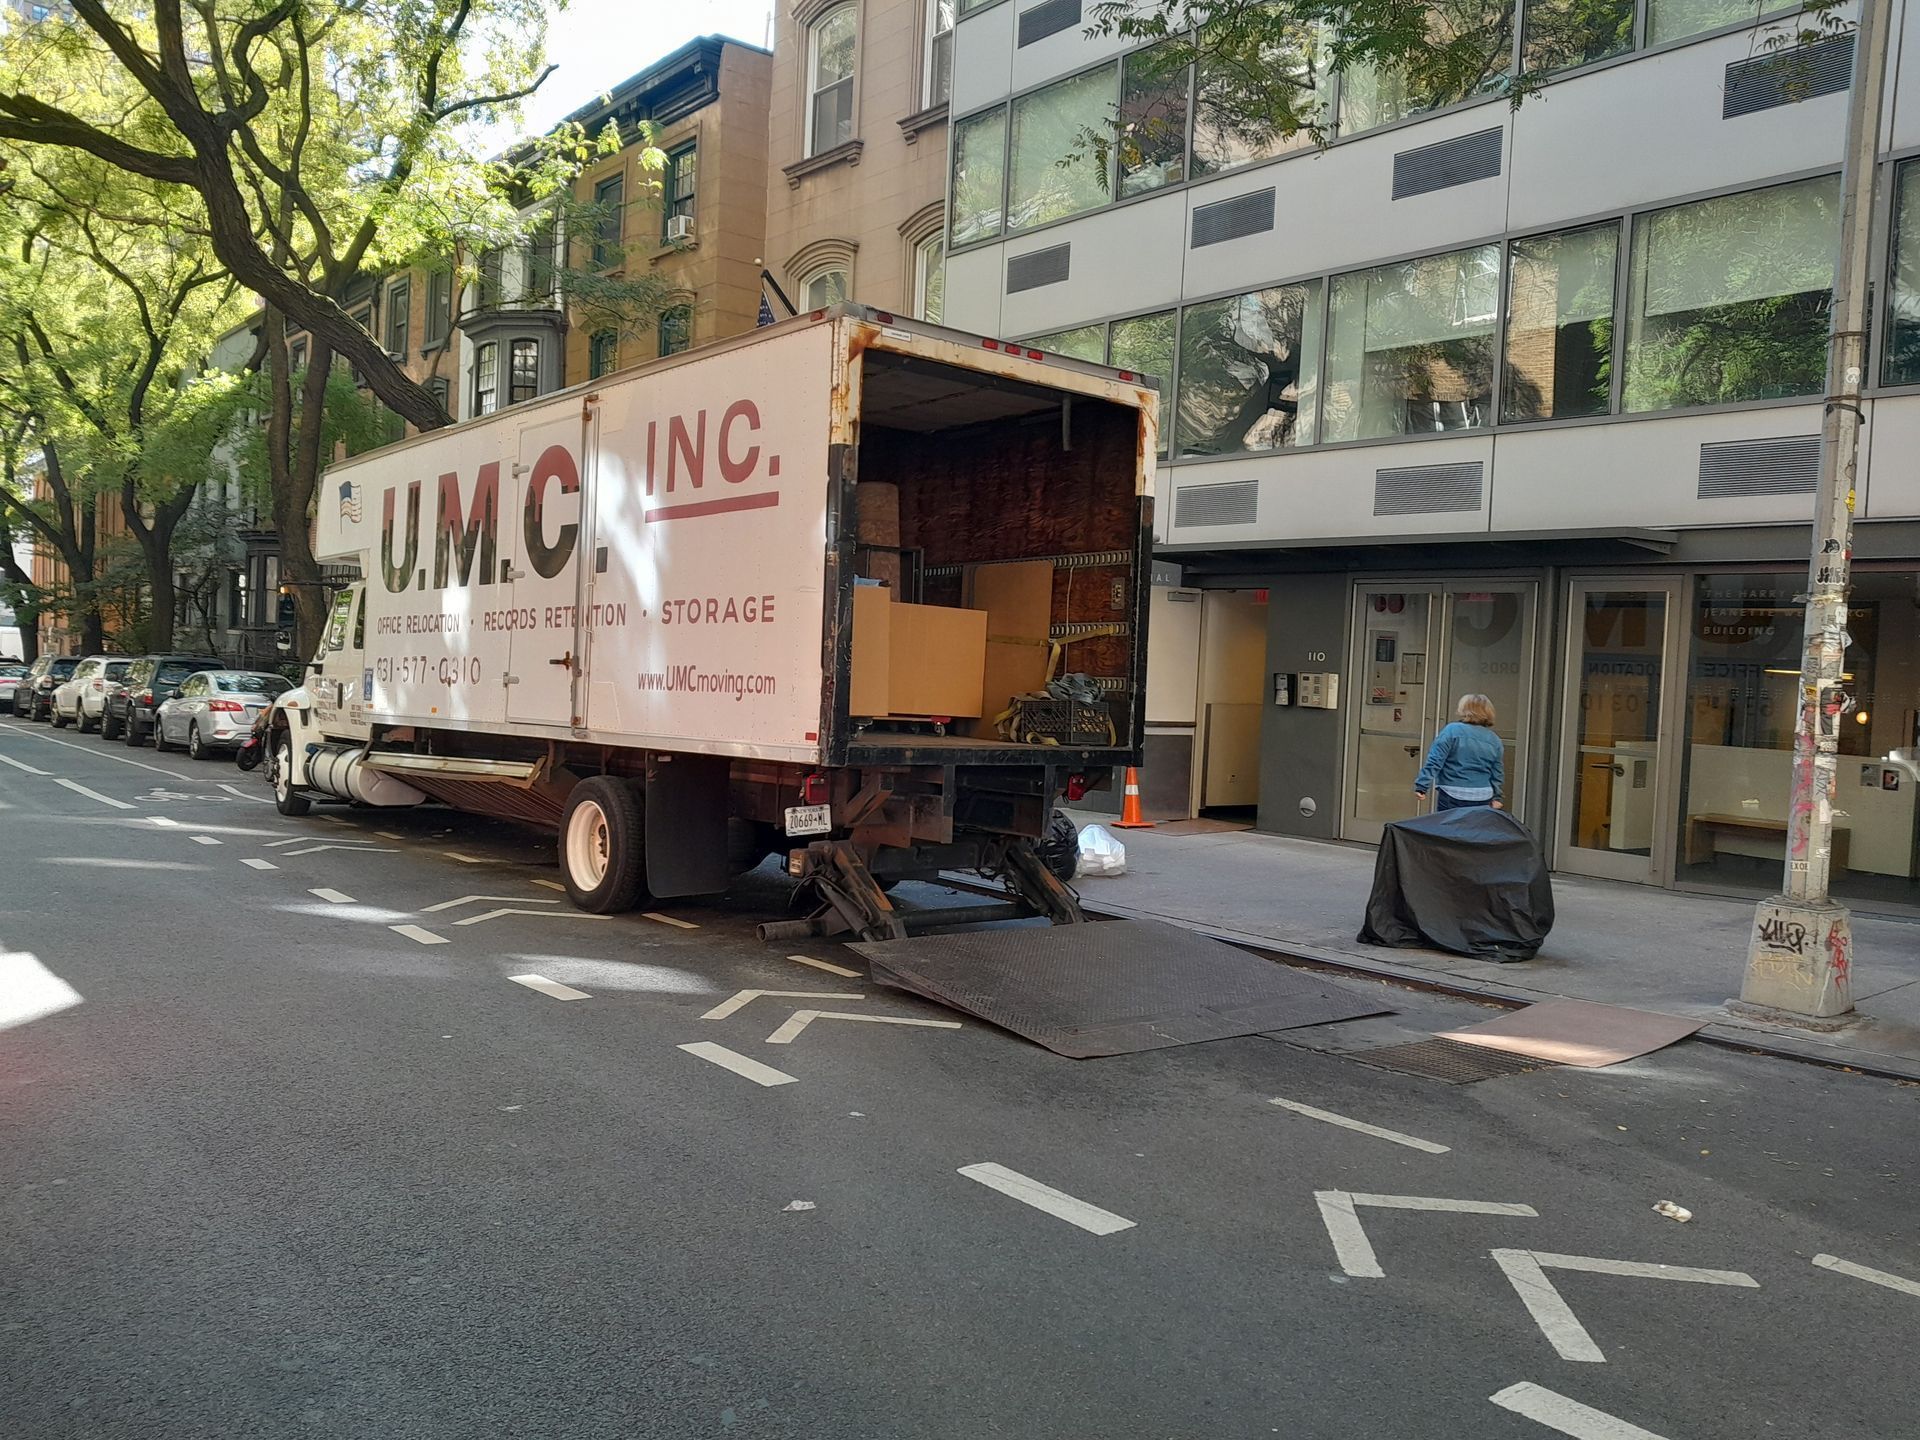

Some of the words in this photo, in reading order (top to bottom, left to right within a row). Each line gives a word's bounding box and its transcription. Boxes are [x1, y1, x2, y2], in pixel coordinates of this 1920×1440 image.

[646, 399, 780, 496] INC.
[381, 444, 608, 593] U.M.C.
[1704, 589, 1732, 599] THE
[1738, 588, 1785, 598] HARRY
[377, 616, 402, 635] OFFICE
[406, 613, 460, 634] RELOCATION
[484, 608, 536, 632] RECORDS
[662, 596, 776, 625] STORAGE
[1703, 626, 1776, 636] BUILDING
[638, 665, 776, 701] www.UMCmoving.com
